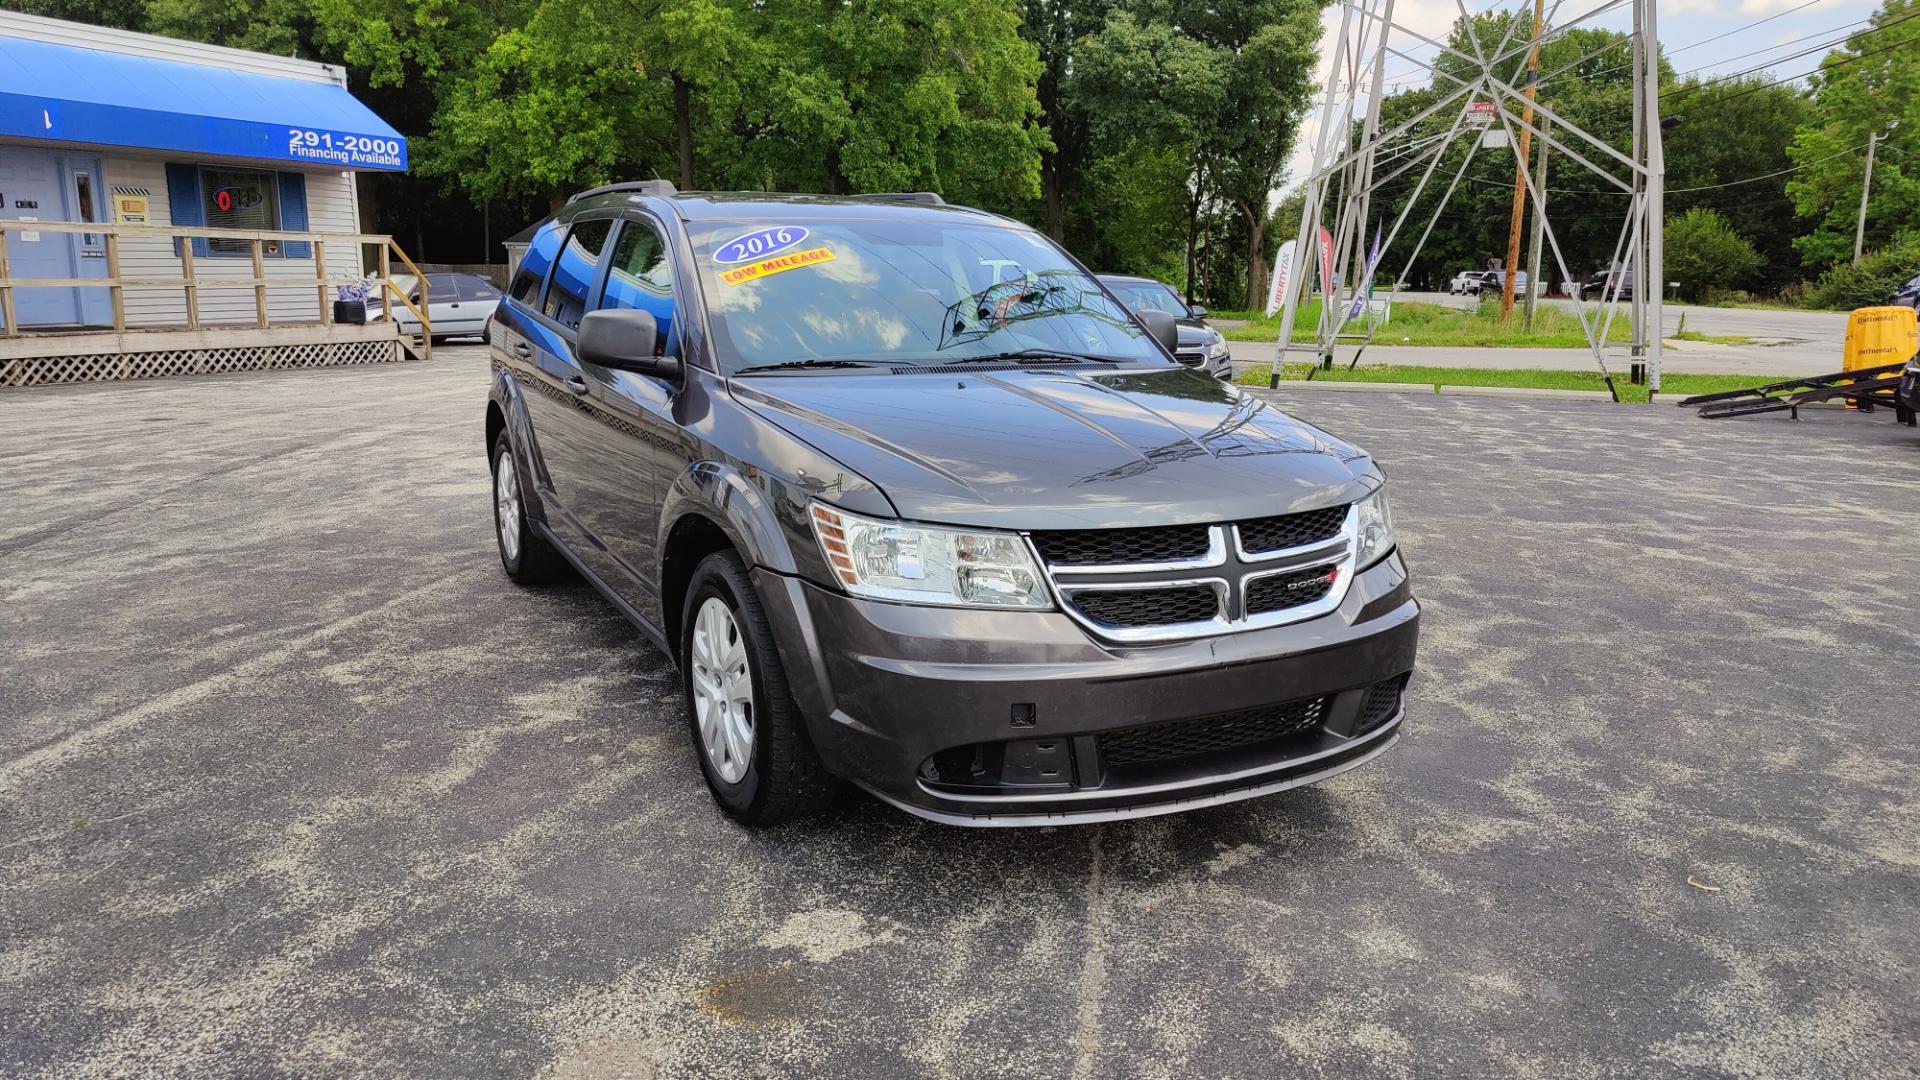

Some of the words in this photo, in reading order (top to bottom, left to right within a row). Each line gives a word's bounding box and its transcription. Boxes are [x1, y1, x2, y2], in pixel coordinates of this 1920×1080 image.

[289, 129, 399, 155] 291-2000
[290, 144, 349, 163] Financing
[351, 150, 401, 166] Available
[731, 228, 792, 261] 2016
[723, 266, 757, 283] LOW
[762, 249, 830, 272] MILEAGE
[1287, 575, 1331, 590] DODGE
